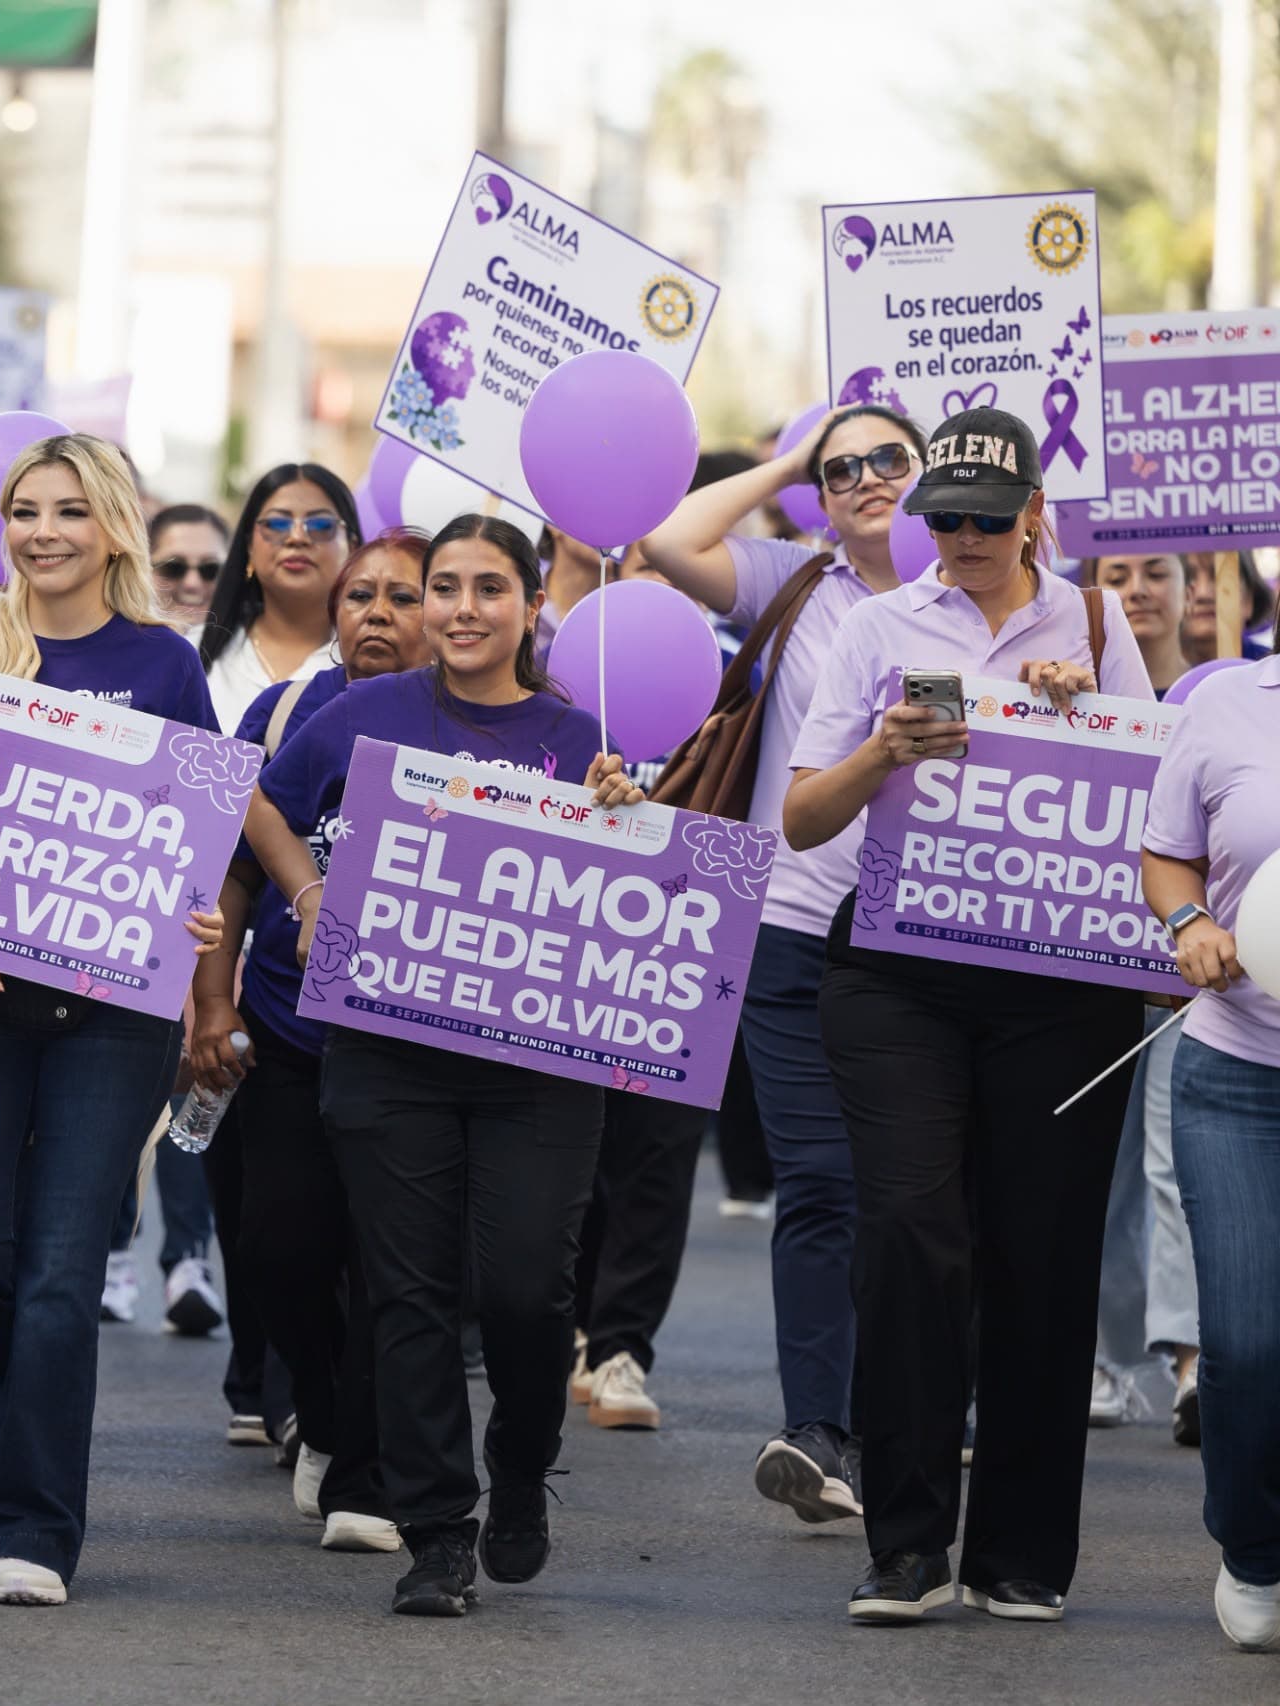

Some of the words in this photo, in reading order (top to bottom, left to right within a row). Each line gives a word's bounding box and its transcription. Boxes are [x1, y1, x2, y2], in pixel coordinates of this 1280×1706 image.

[512, 201, 580, 255] ALMA
[880, 221, 954, 247] ALMA
[462, 281, 494, 306] por
[495, 299, 560, 345] quienes
[561, 336, 584, 355] no
[486, 255, 641, 353] Caminamos
[885, 293, 925, 320] Los
[932, 286, 1043, 317] recuerdos
[908, 328, 933, 348] se
[939, 319, 1021, 352] quedan
[1224, 326, 1248, 341] DIF
[895, 360, 923, 378] en
[927, 352, 945, 376] el
[951, 348, 1043, 374] corazón.
[480, 371, 501, 395] los
[926, 432, 1018, 475] SELENA
[1192, 425, 1227, 451] LA
[953, 469, 978, 478] FDLF
[1165, 453, 1221, 483] NO
[95, 690, 133, 701] ALMA
[48, 707, 79, 727] DIF
[1030, 704, 1059, 717] ALMA
[1088, 713, 1118, 730] DIF
[404, 768, 448, 789] Rotary
[502, 789, 532, 806] ALMA
[561, 804, 592, 824] DIF
[908, 758, 1150, 854] SEGUI
[371, 819, 461, 898] EL
[477, 847, 721, 955] AMOR
[895, 878, 988, 926] POR
[996, 894, 1033, 932] TI
[1042, 900, 1075, 937] Y
[1080, 906, 1171, 954] POR
[359, 890, 570, 983] PUEDE
[576, 941, 708, 1011] MÁS
[904, 924, 918, 934] 21
[924, 926, 940, 938] DE
[945, 929, 1025, 951] SEPTIEMBRE
[1030, 941, 1051, 954] DÍA
[1057, 946, 1114, 964] MUNDIAL
[1119, 956, 1143, 969] DEL
[40, 951, 63, 966] DEL
[68, 959, 141, 988] ALZHEIMER
[347, 951, 446, 1003] QUE
[451, 973, 504, 1017] EL
[353, 998, 369, 1010] 21
[374, 1003, 391, 1015] DE
[395, 1008, 476, 1035] SEPTIEMBRE
[481, 1026, 504, 1040] DÍA
[509, 1033, 569, 1055] MUNDIAL
[573, 1047, 598, 1062] DEL
[602, 1055, 679, 1079] ALZHEIMER
